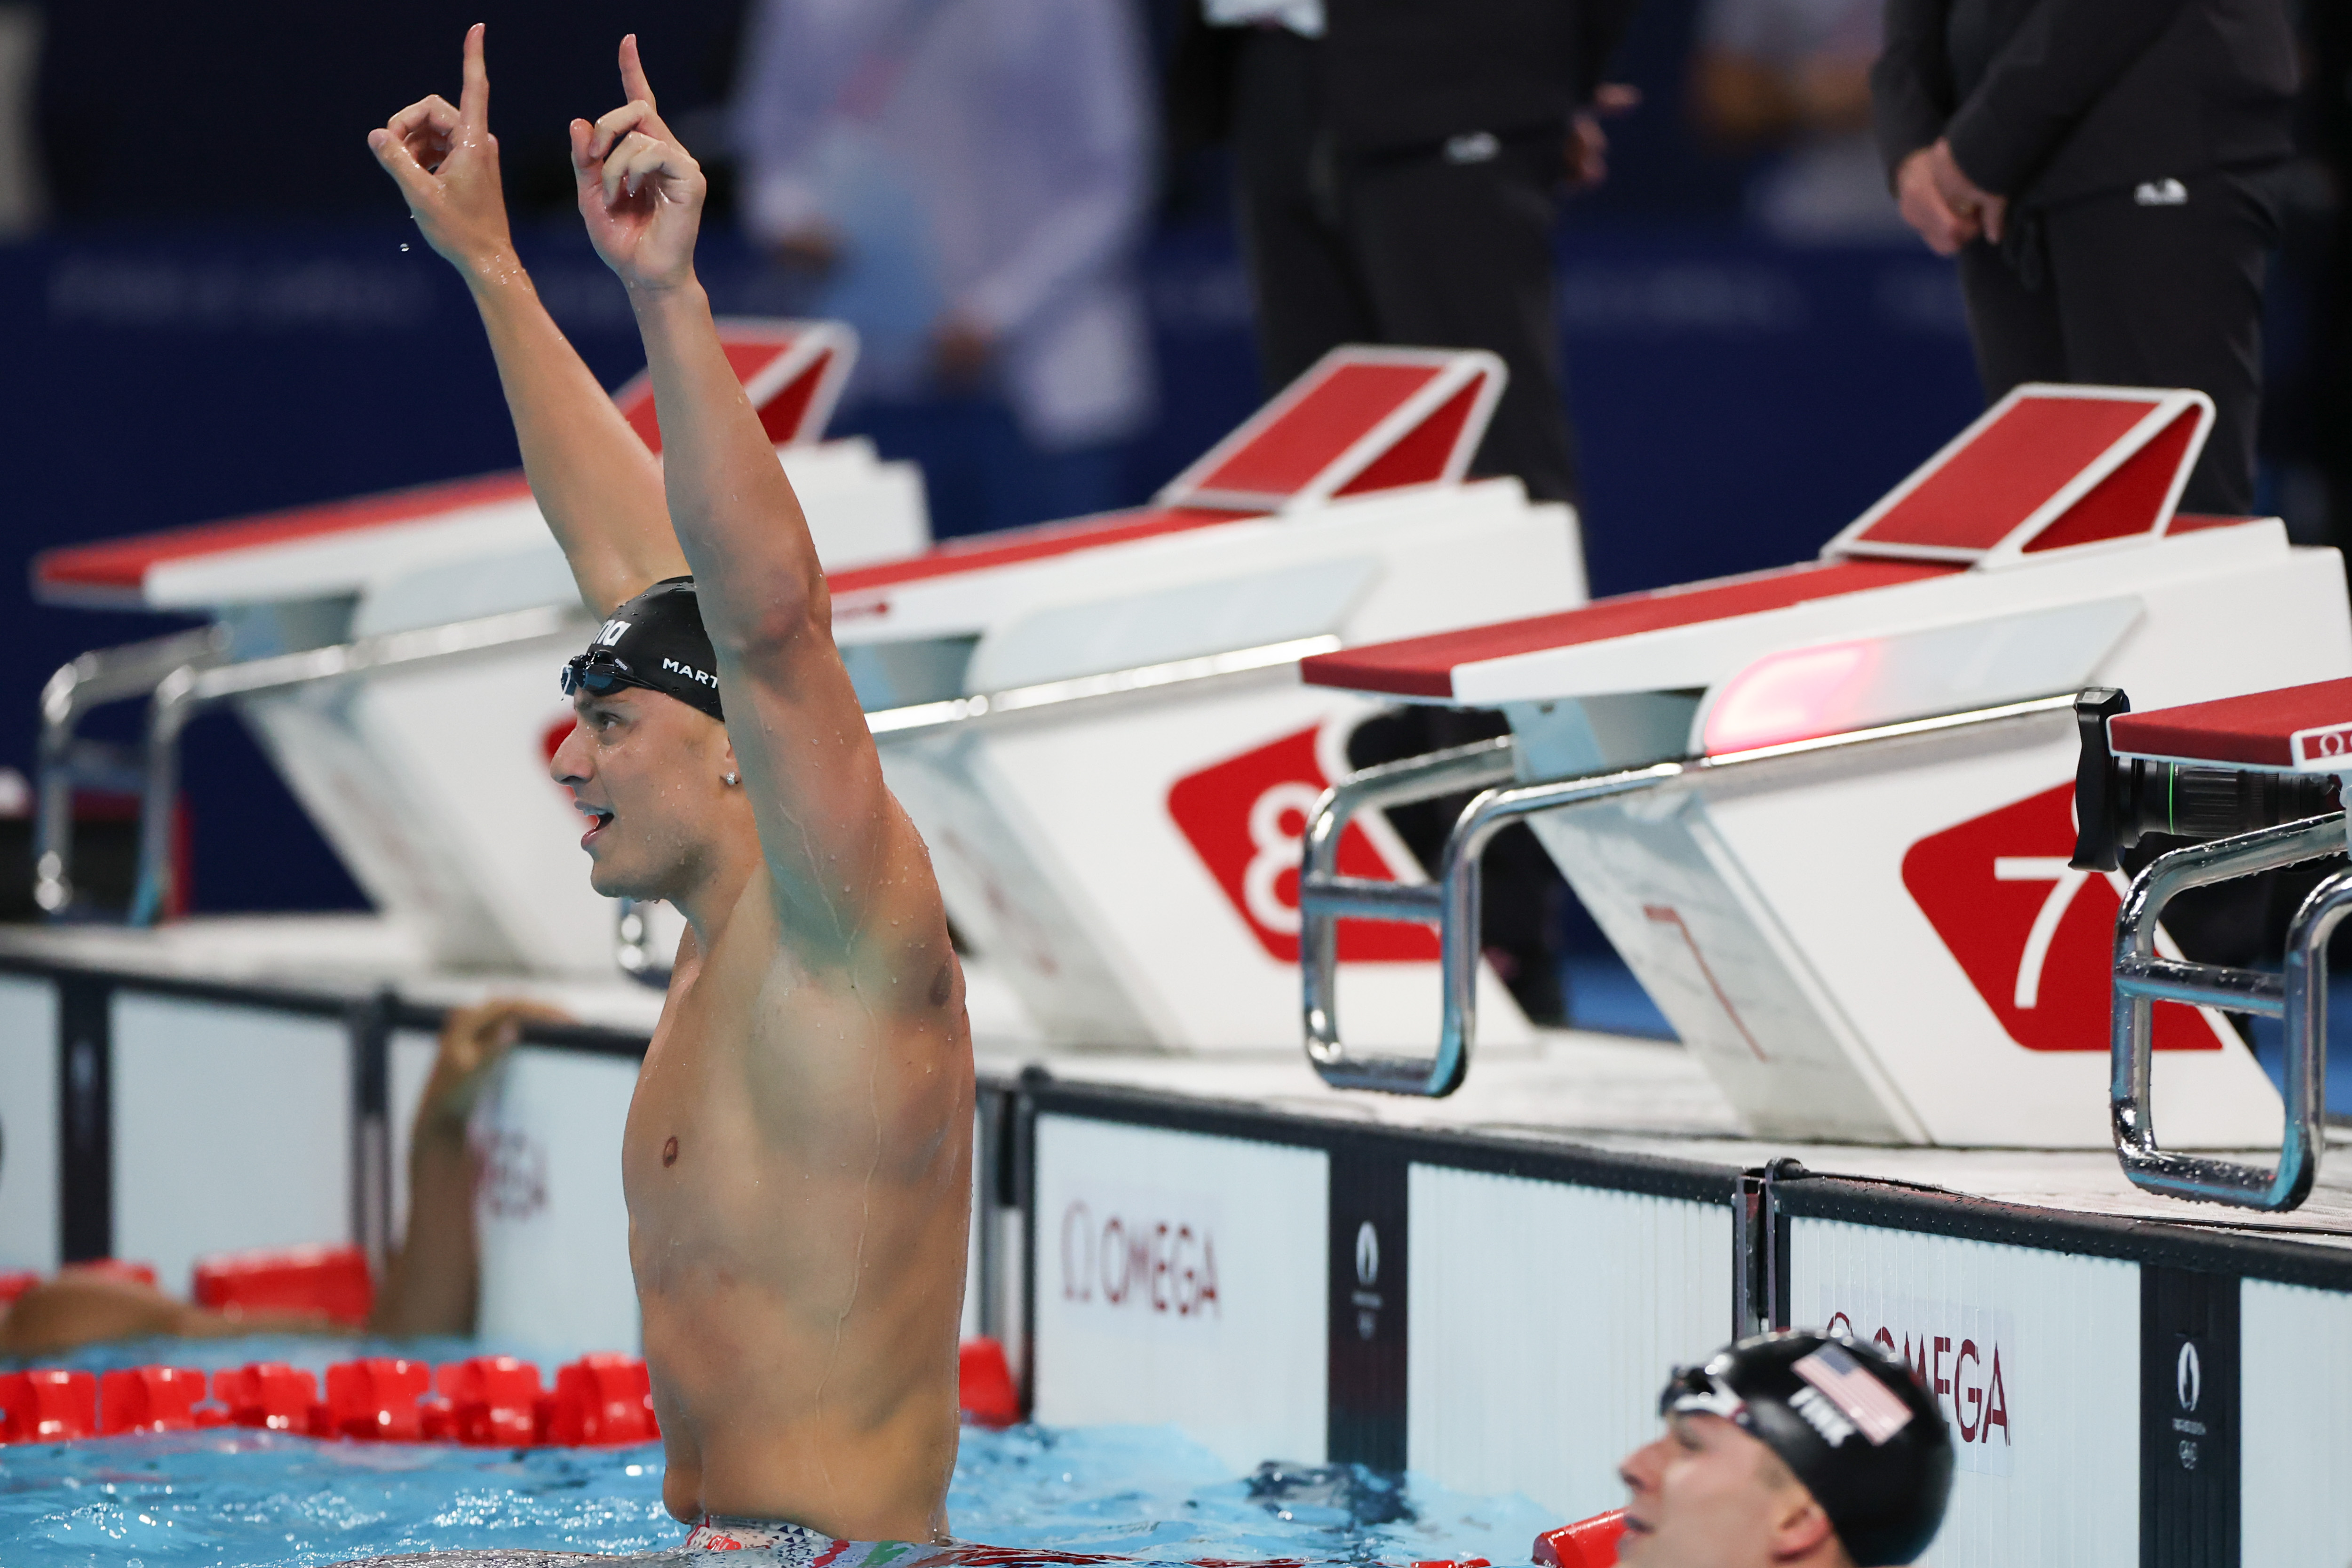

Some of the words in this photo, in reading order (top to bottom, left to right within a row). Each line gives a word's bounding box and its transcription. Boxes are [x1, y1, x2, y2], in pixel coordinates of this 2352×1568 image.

[662, 658, 718, 689] MART
[1243, 780, 1324, 935] 8
[1643, 904, 1770, 1064] 7
[1994, 856, 2090, 1010] 7
[1099, 1215, 1222, 1319] OMEGA
[1873, 1326, 2011, 1447] EGA
